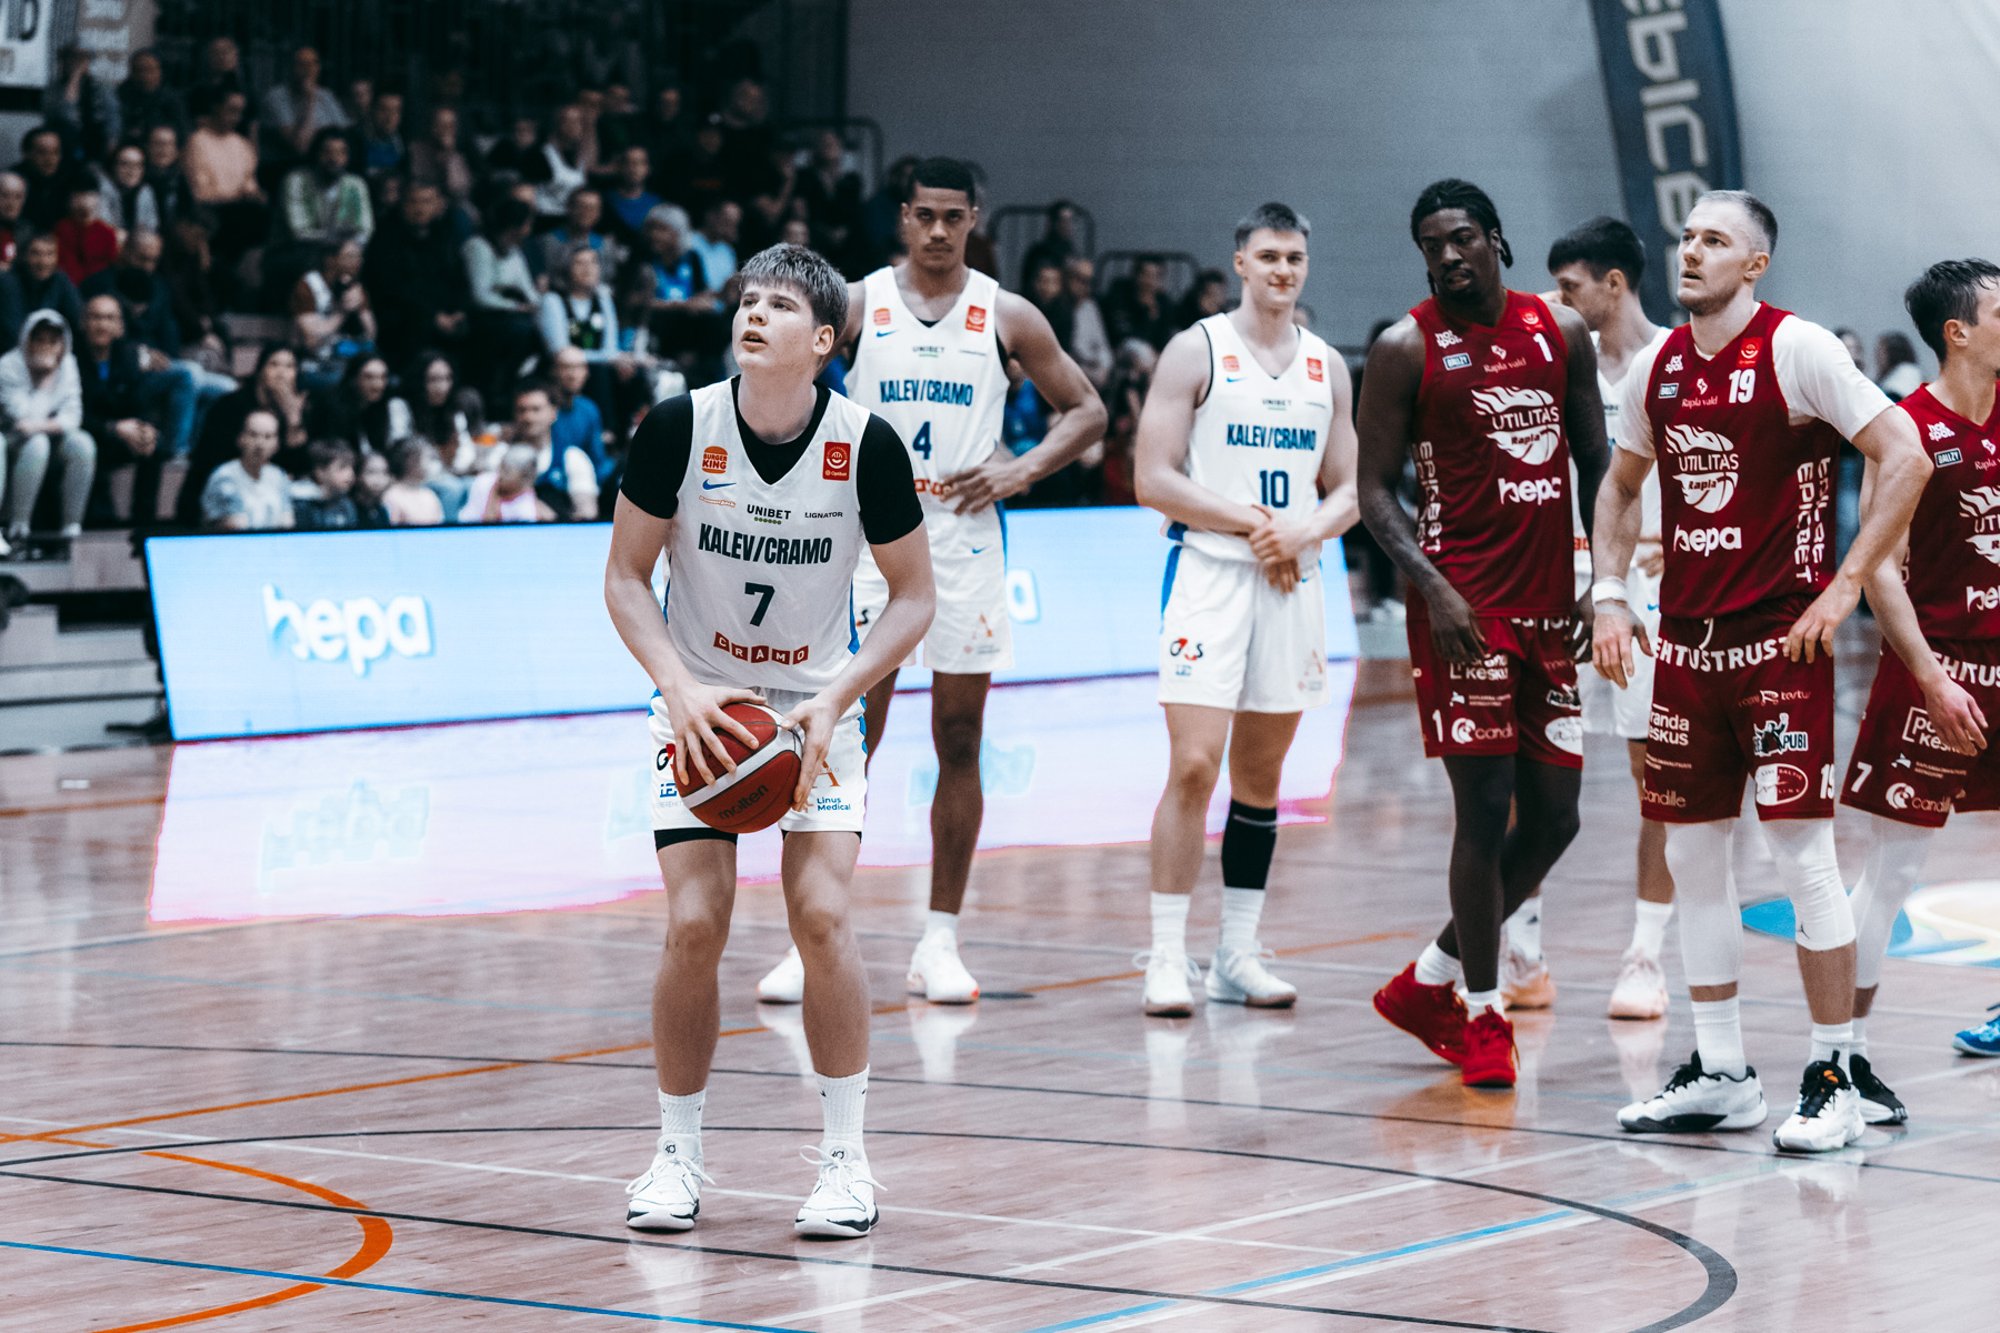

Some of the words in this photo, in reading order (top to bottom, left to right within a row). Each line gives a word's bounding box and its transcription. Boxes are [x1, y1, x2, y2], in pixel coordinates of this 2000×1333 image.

[1533, 333, 1553, 362] 1
[879, 378, 974, 407] KALEV/CRAMO
[1728, 368, 1756, 404] 19
[1492, 406, 1560, 430] UTILITAS
[912, 421, 933, 460] 4
[1226, 423, 1317, 452] KALEV/CRAMO
[1511, 433, 1541, 446] Rapla
[702, 460, 727, 470] KING
[703, 453, 728, 462] BURGER
[1678, 453, 1740, 472] UTILITAS
[1259, 470, 1289, 509] 10
[747, 503, 791, 520] UNIBET
[805, 511, 843, 519] LIGNATOR
[698, 523, 833, 565] KALEV/CRAMO
[1674, 524, 1743, 557] hepa
[744, 581, 775, 627] 7
[262, 583, 436, 679] hepa
[715, 633, 808, 665] CRAMO
[1432, 709, 1444, 743] 1
[1782, 733, 1807, 750] PUBI
[1851, 762, 1873, 793] 7
[719, 784, 769, 820] molten
[817, 796, 842, 804] Linus
[817, 803, 852, 812] Medical
